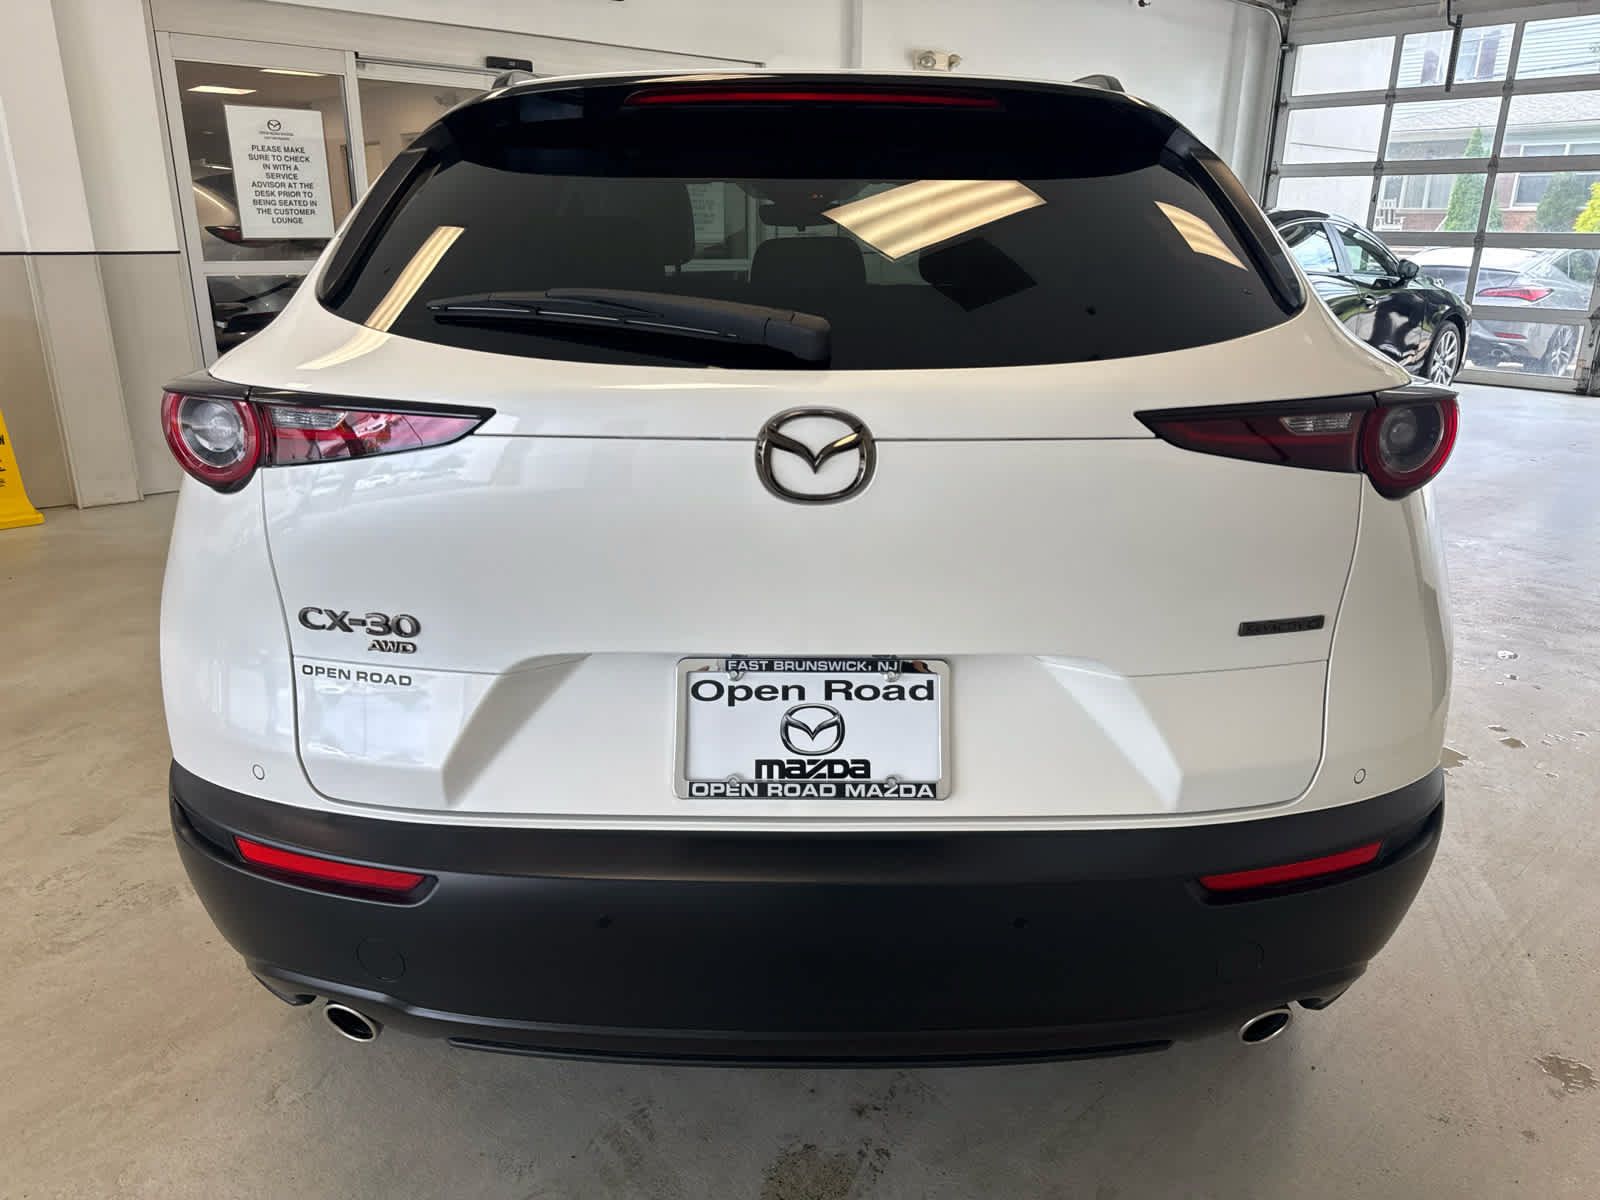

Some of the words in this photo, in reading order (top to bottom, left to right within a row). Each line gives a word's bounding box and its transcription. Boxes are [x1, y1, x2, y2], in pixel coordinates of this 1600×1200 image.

[297, 606, 422, 638] CX-30
[367, 639, 418, 655] AWD
[302, 664, 351, 680] OPEN
[356, 671, 412, 686] ROAD
[728, 660, 768, 671] EAST
[773, 660, 872, 672] BRUNSWICK,
[877, 660, 898, 671] NJ
[690, 680, 806, 707] Open
[824, 680, 934, 701] Road
[691, 782, 758, 797] OPEN
[767, 783, 836, 797] ROAD
[845, 783, 935, 798] MAZDA
